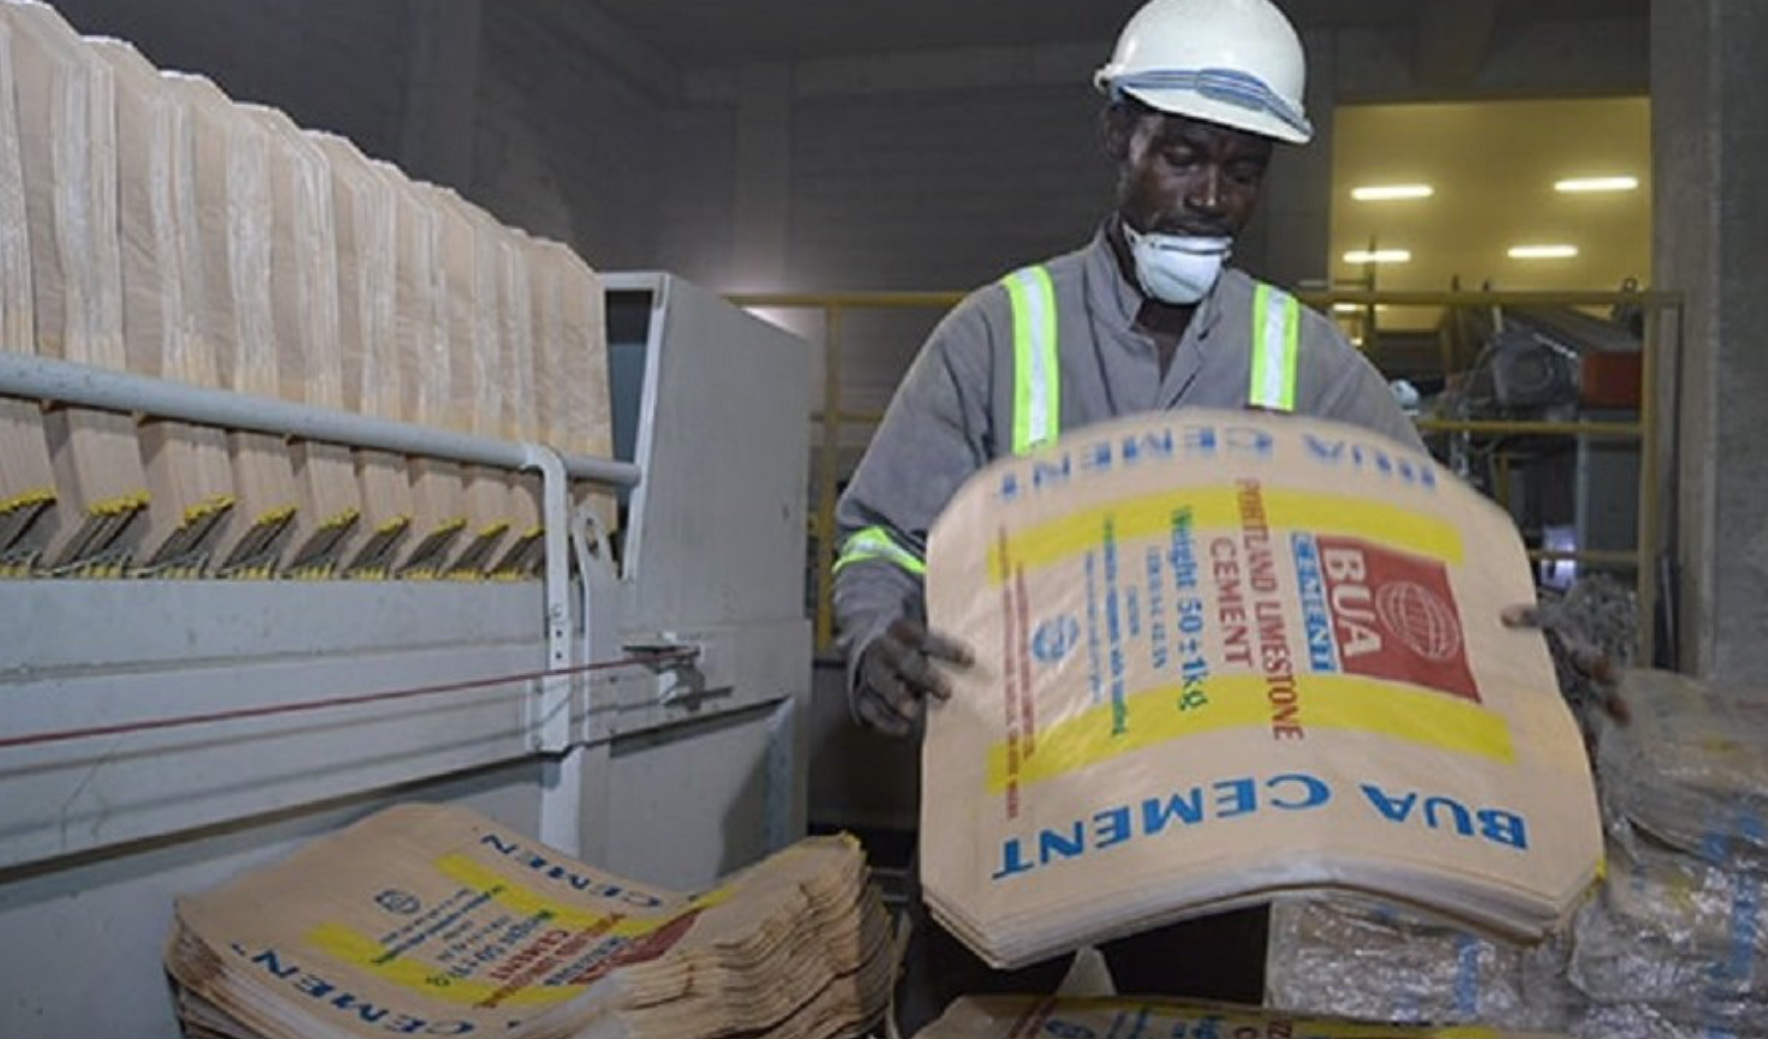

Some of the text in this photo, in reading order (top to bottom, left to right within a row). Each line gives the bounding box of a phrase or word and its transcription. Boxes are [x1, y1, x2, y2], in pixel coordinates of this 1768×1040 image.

[1167, 504, 1198, 590] Weight
[1211, 537, 1252, 668] CEMENT
[1292, 532, 1337, 672] CEMENT
[1323, 549, 1383, 658] BUA
[1236, 479, 1305, 742] PORTLAND LIMESTONE
[992, 774, 1528, 880] BUA CEMENT
